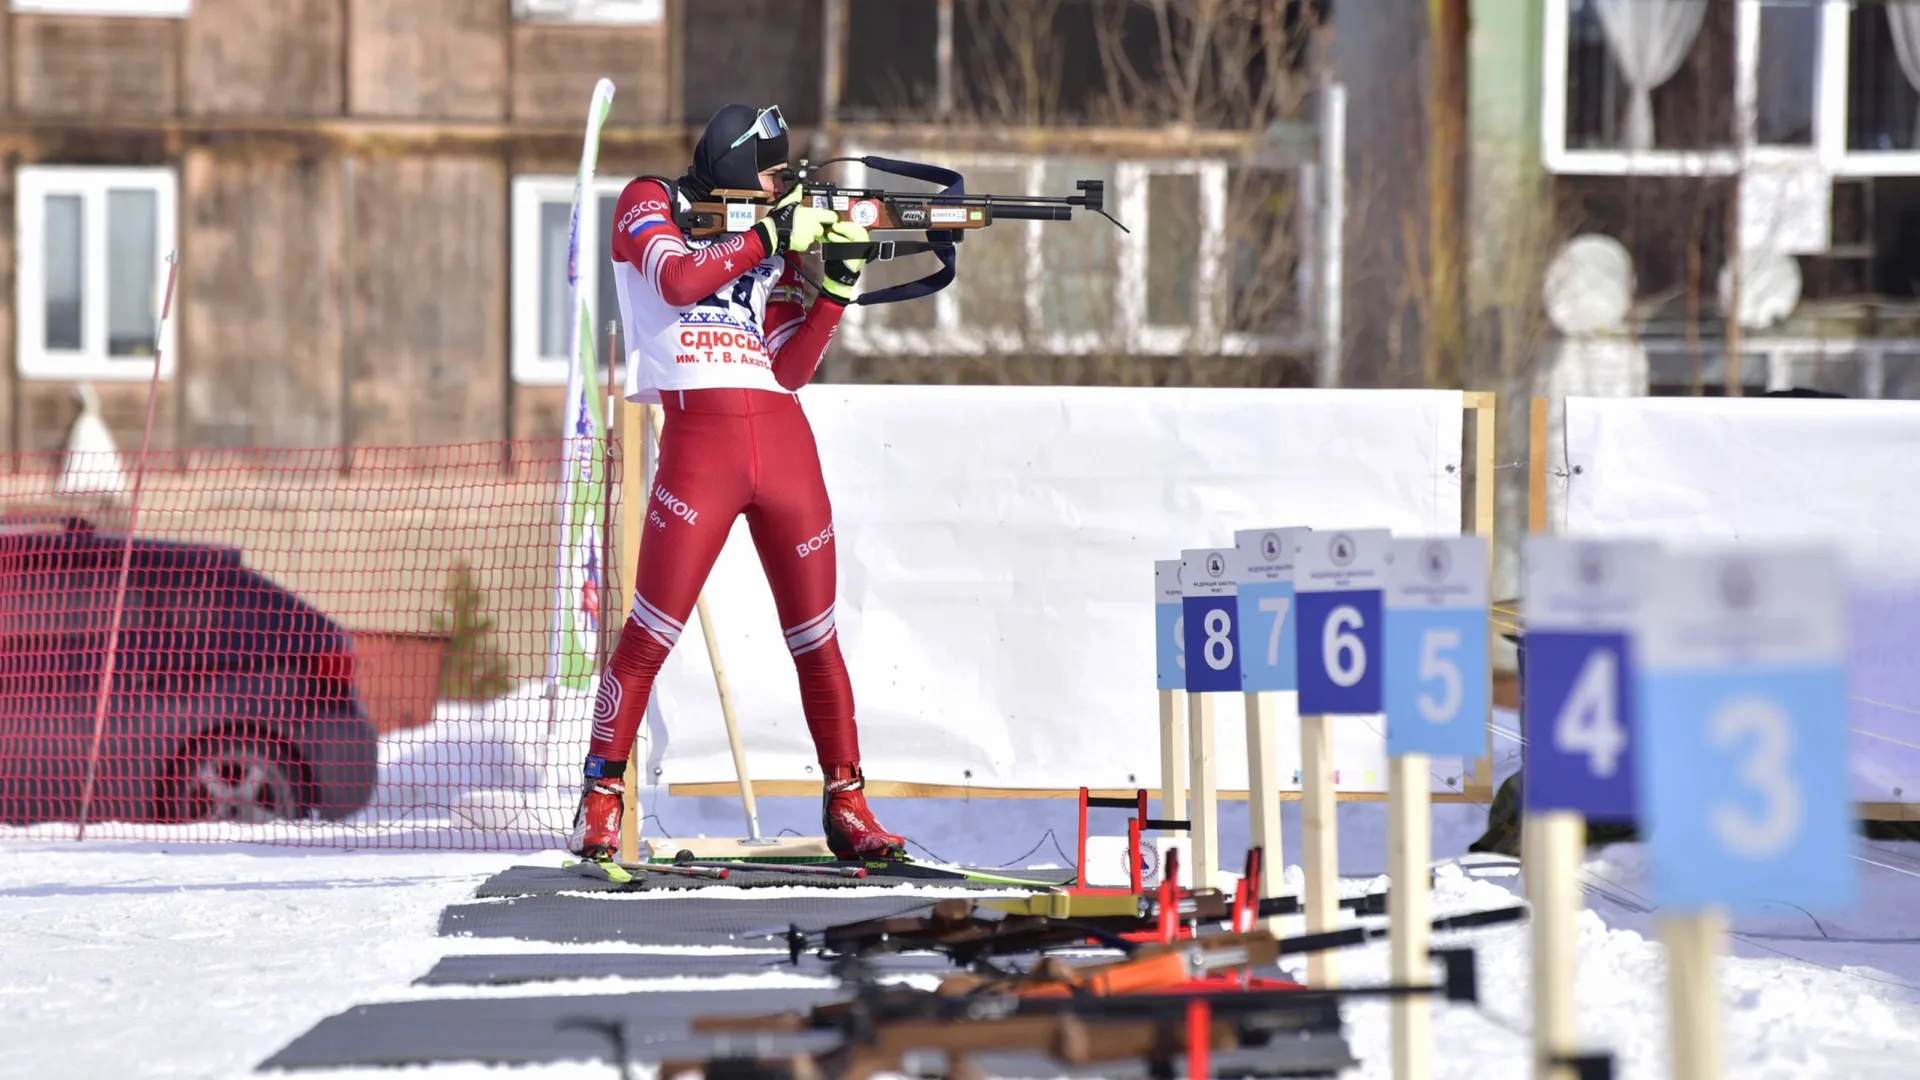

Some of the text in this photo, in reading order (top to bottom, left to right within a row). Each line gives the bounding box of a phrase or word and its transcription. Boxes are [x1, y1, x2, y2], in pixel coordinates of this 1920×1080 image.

[617, 200, 661, 233] BOSCO
[729, 211, 753, 219] VEKA
[676, 354, 700, 364] им.
[704, 352, 718, 363] Т.
[723, 352, 736, 363] В.
[655, 484, 699, 526] LUKOIL
[1204, 608, 1234, 671] 8
[1258, 597, 1290, 666] 7
[1322, 604, 1367, 688] 6
[1417, 628, 1463, 725] 5
[1555, 648, 1628, 778] 4
[1709, 695, 1803, 859] 3
